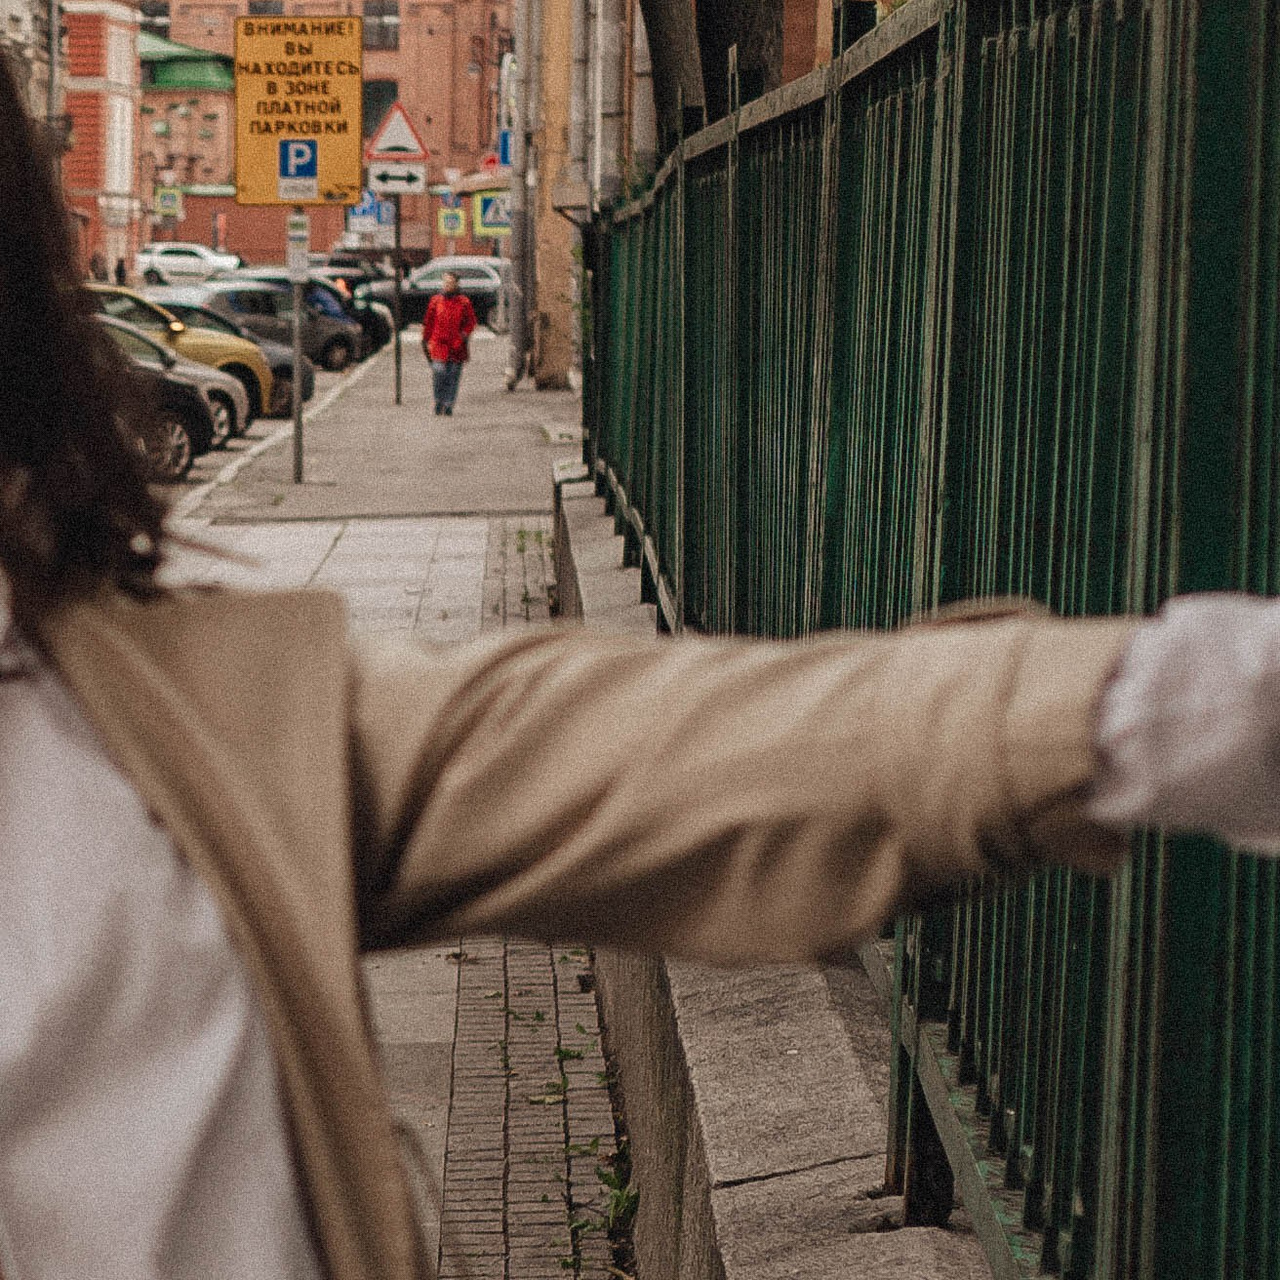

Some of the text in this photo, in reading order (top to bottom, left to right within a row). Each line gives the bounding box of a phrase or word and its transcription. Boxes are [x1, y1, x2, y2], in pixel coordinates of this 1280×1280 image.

[244, 21, 354, 36] ВНИМАНИЕ!
[285, 41, 313, 56] ВЫ
[236, 61, 360, 77] НАХОДИТЕСЬ
[266, 81, 330, 95] В ЗОНЕ
[256, 96, 342, 115] ПЛАТНОЙ
[250, 120, 349, 134] ПАРКОВКИ
[287, 142, 313, 176] P
